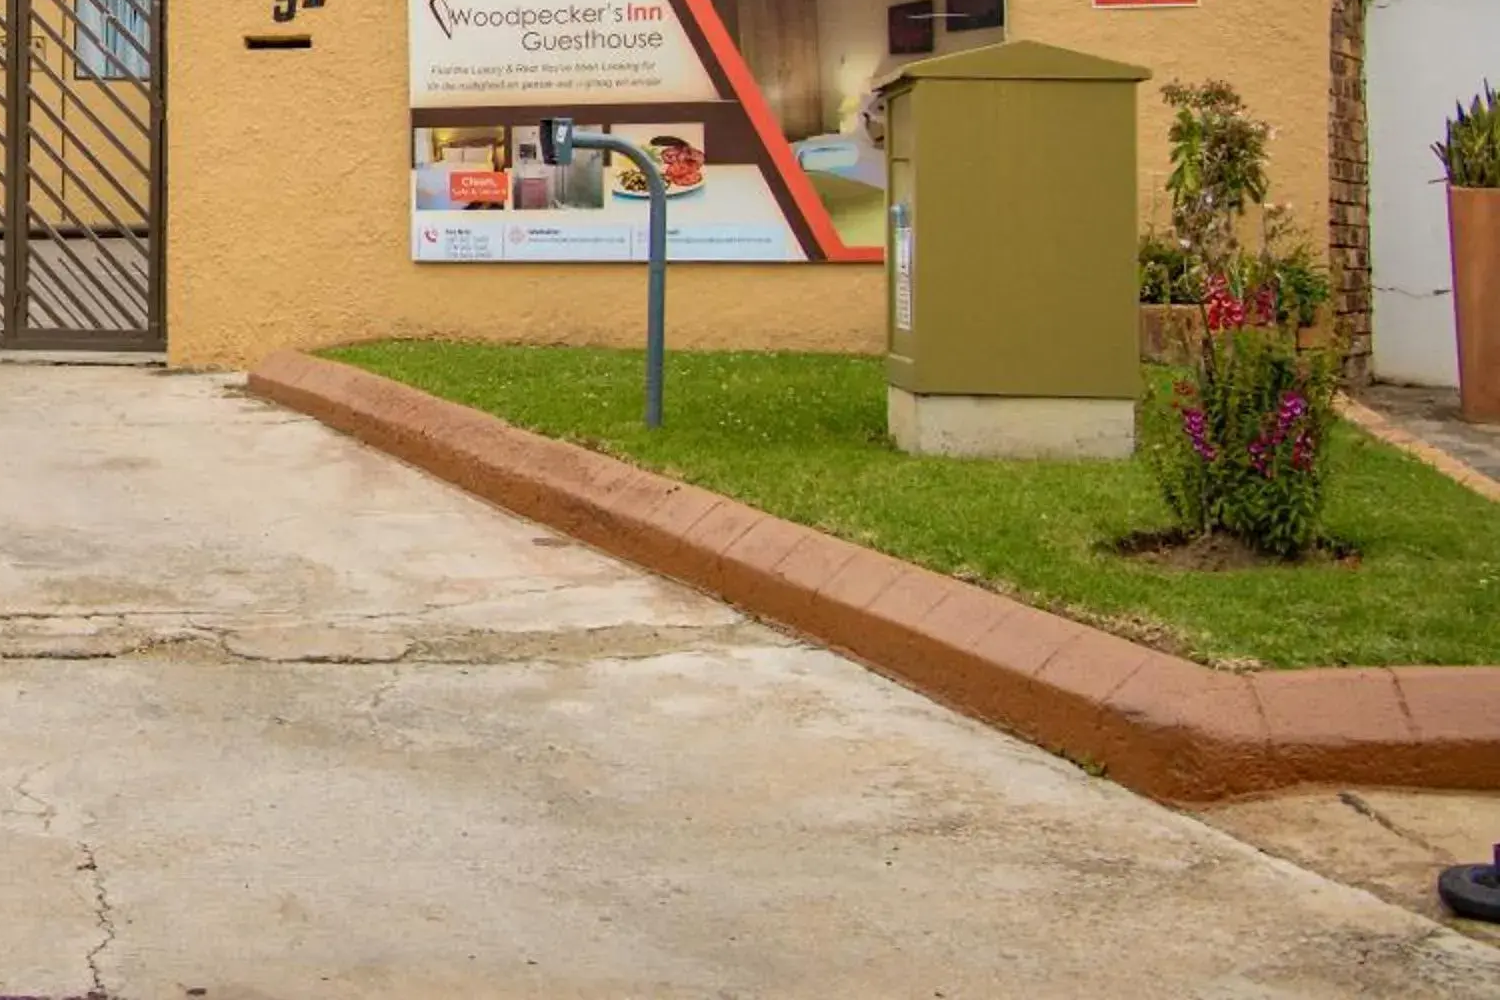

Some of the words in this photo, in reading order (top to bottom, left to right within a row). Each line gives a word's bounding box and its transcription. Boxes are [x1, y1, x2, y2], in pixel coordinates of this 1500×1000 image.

[450, 1, 624, 28] Woodpecker's
[626, 2, 662, 22] Inn
[521, 30, 664, 52] Guesthouse
